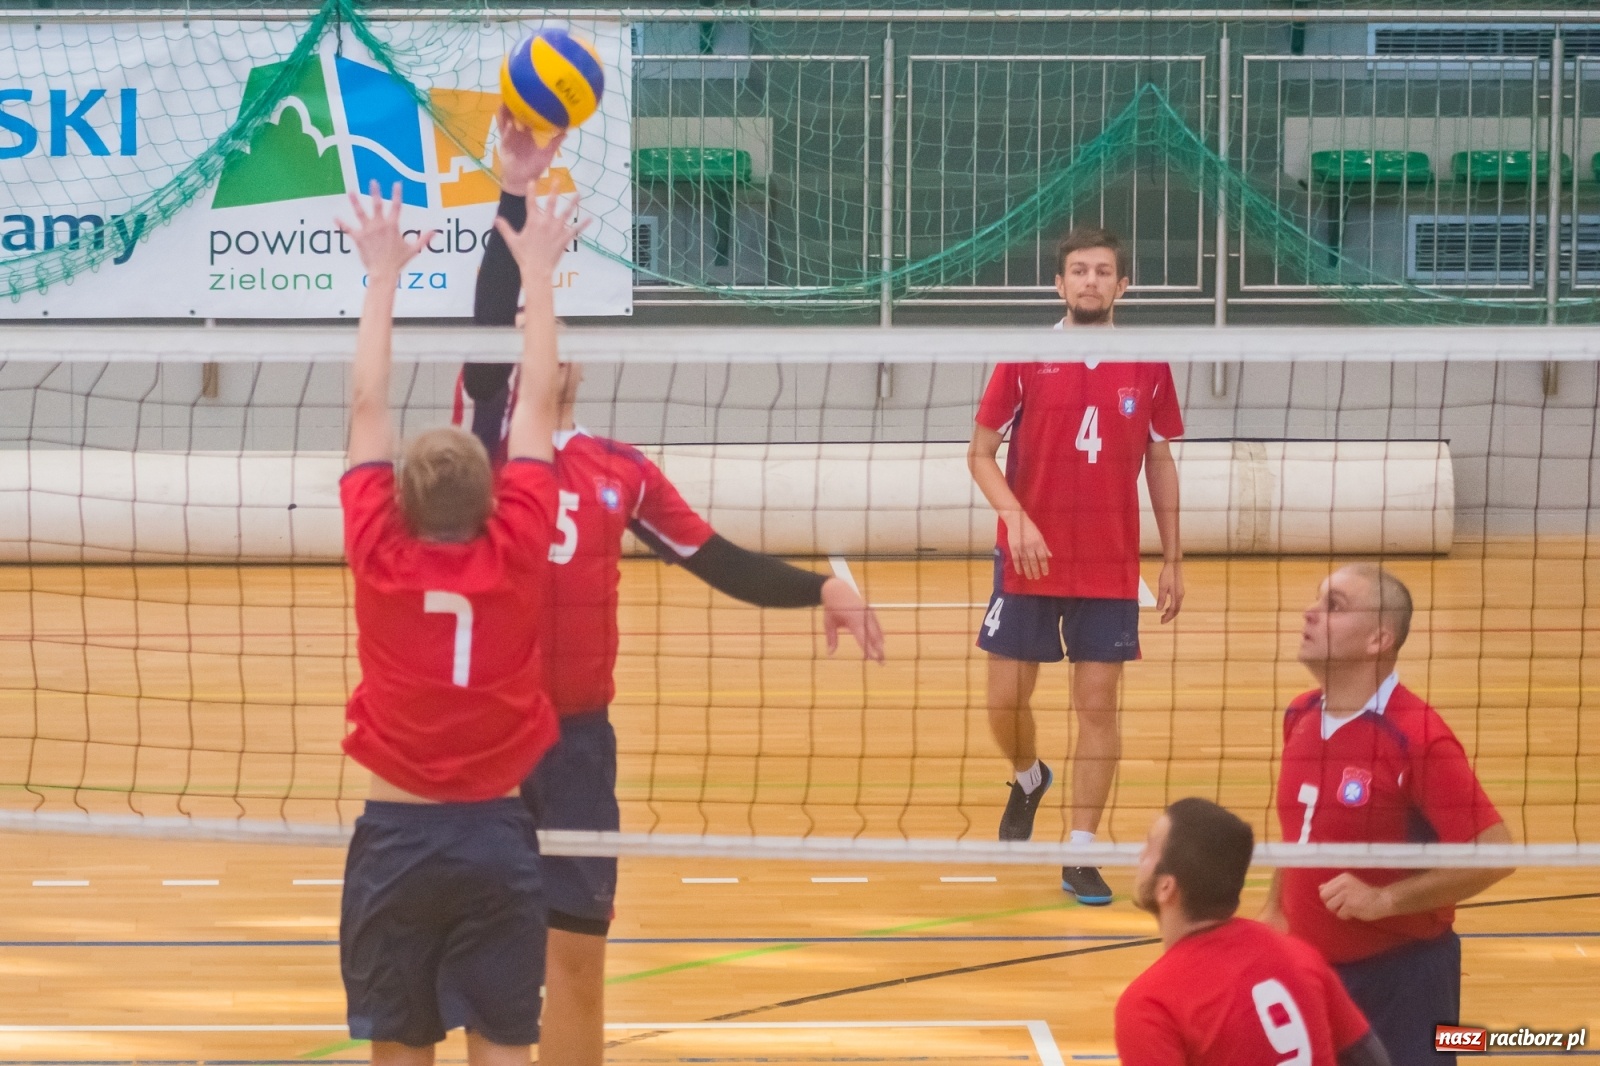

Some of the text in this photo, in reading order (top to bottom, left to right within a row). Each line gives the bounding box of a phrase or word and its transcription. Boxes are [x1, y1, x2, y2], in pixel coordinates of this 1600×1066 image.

[0, 88, 137, 159] SKI
[1, 214, 148, 265] amy
[210, 219, 351, 265] powiat
[209, 268, 333, 290] zielona
[1075, 406, 1102, 463] 4
[548, 489, 580, 565] 5
[424, 589, 473, 687] 7
[984, 598, 1004, 637] 4
[1298, 783, 1319, 845] 7
[1252, 978, 1312, 1066] 9
